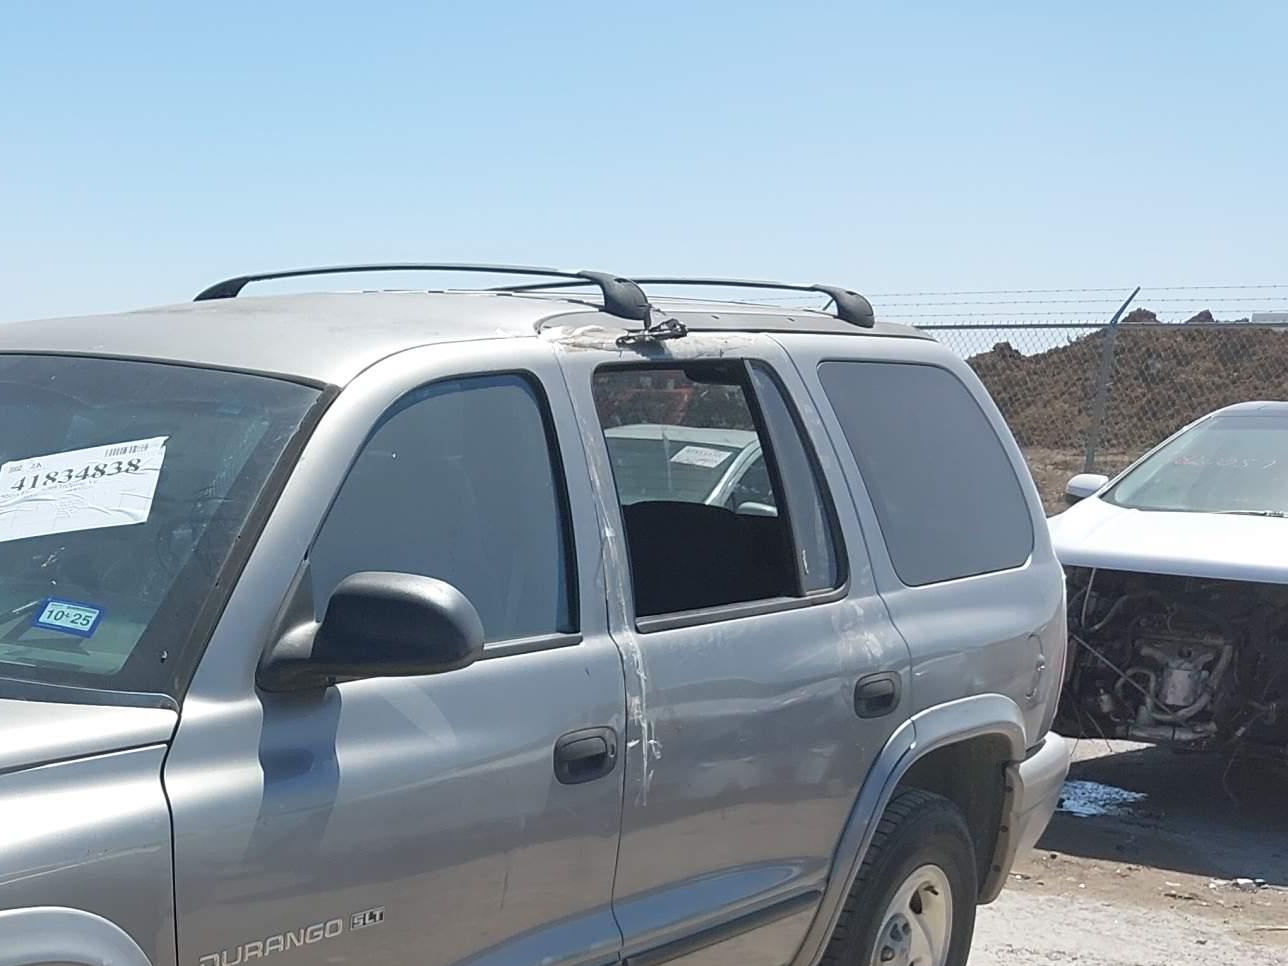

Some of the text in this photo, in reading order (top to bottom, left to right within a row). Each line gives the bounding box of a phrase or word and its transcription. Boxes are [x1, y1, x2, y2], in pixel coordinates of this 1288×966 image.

[10, 458, 142, 491] 41834838
[46, 609, 65, 621] 10
[70, 613, 93, 626] 25
[351, 907, 384, 929] SLT
